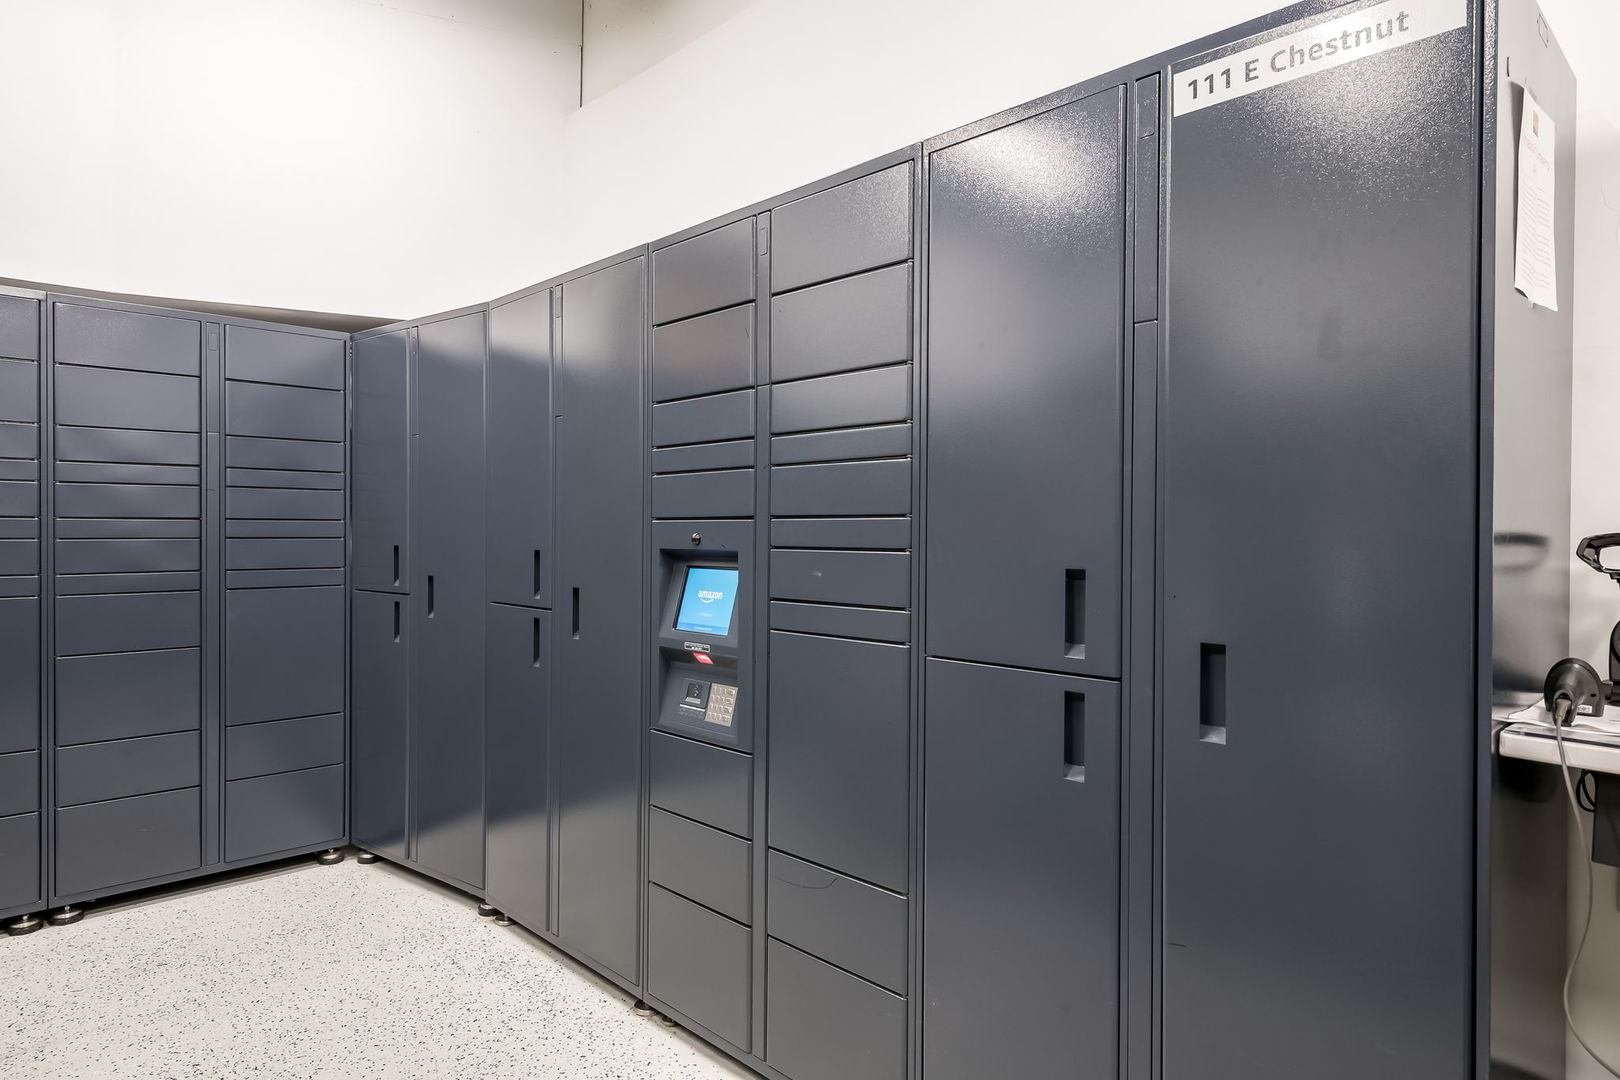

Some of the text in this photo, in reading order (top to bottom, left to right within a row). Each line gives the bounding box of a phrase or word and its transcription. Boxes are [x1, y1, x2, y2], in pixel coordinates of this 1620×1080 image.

[1187, 10, 1410, 99] 111 E Chestnut
[697, 590, 723, 600] amazon
